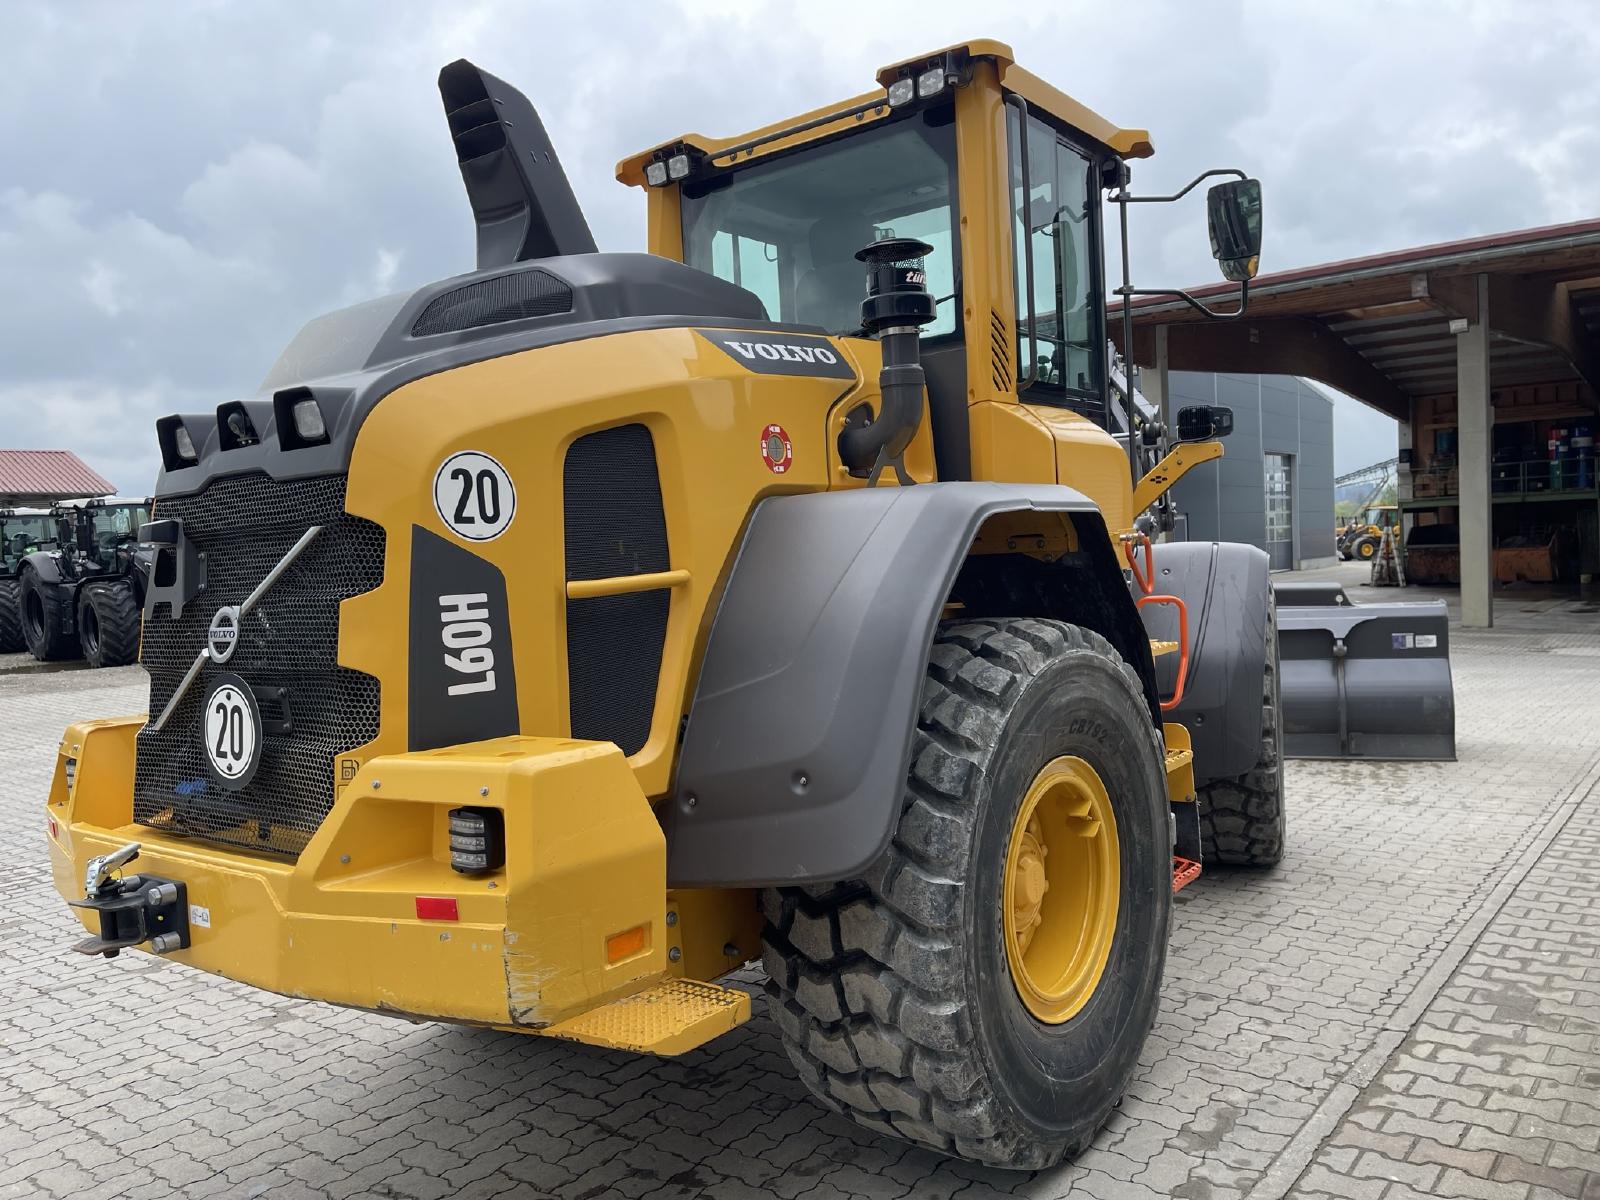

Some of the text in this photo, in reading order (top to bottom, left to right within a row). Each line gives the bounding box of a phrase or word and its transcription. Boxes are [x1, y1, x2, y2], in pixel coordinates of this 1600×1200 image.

[723, 341, 837, 365] VOLVO
[450, 467, 501, 524] 20
[210, 630, 236, 639] VOLVO
[439, 592, 496, 696] L60H
[215, 702, 244, 762] 20
